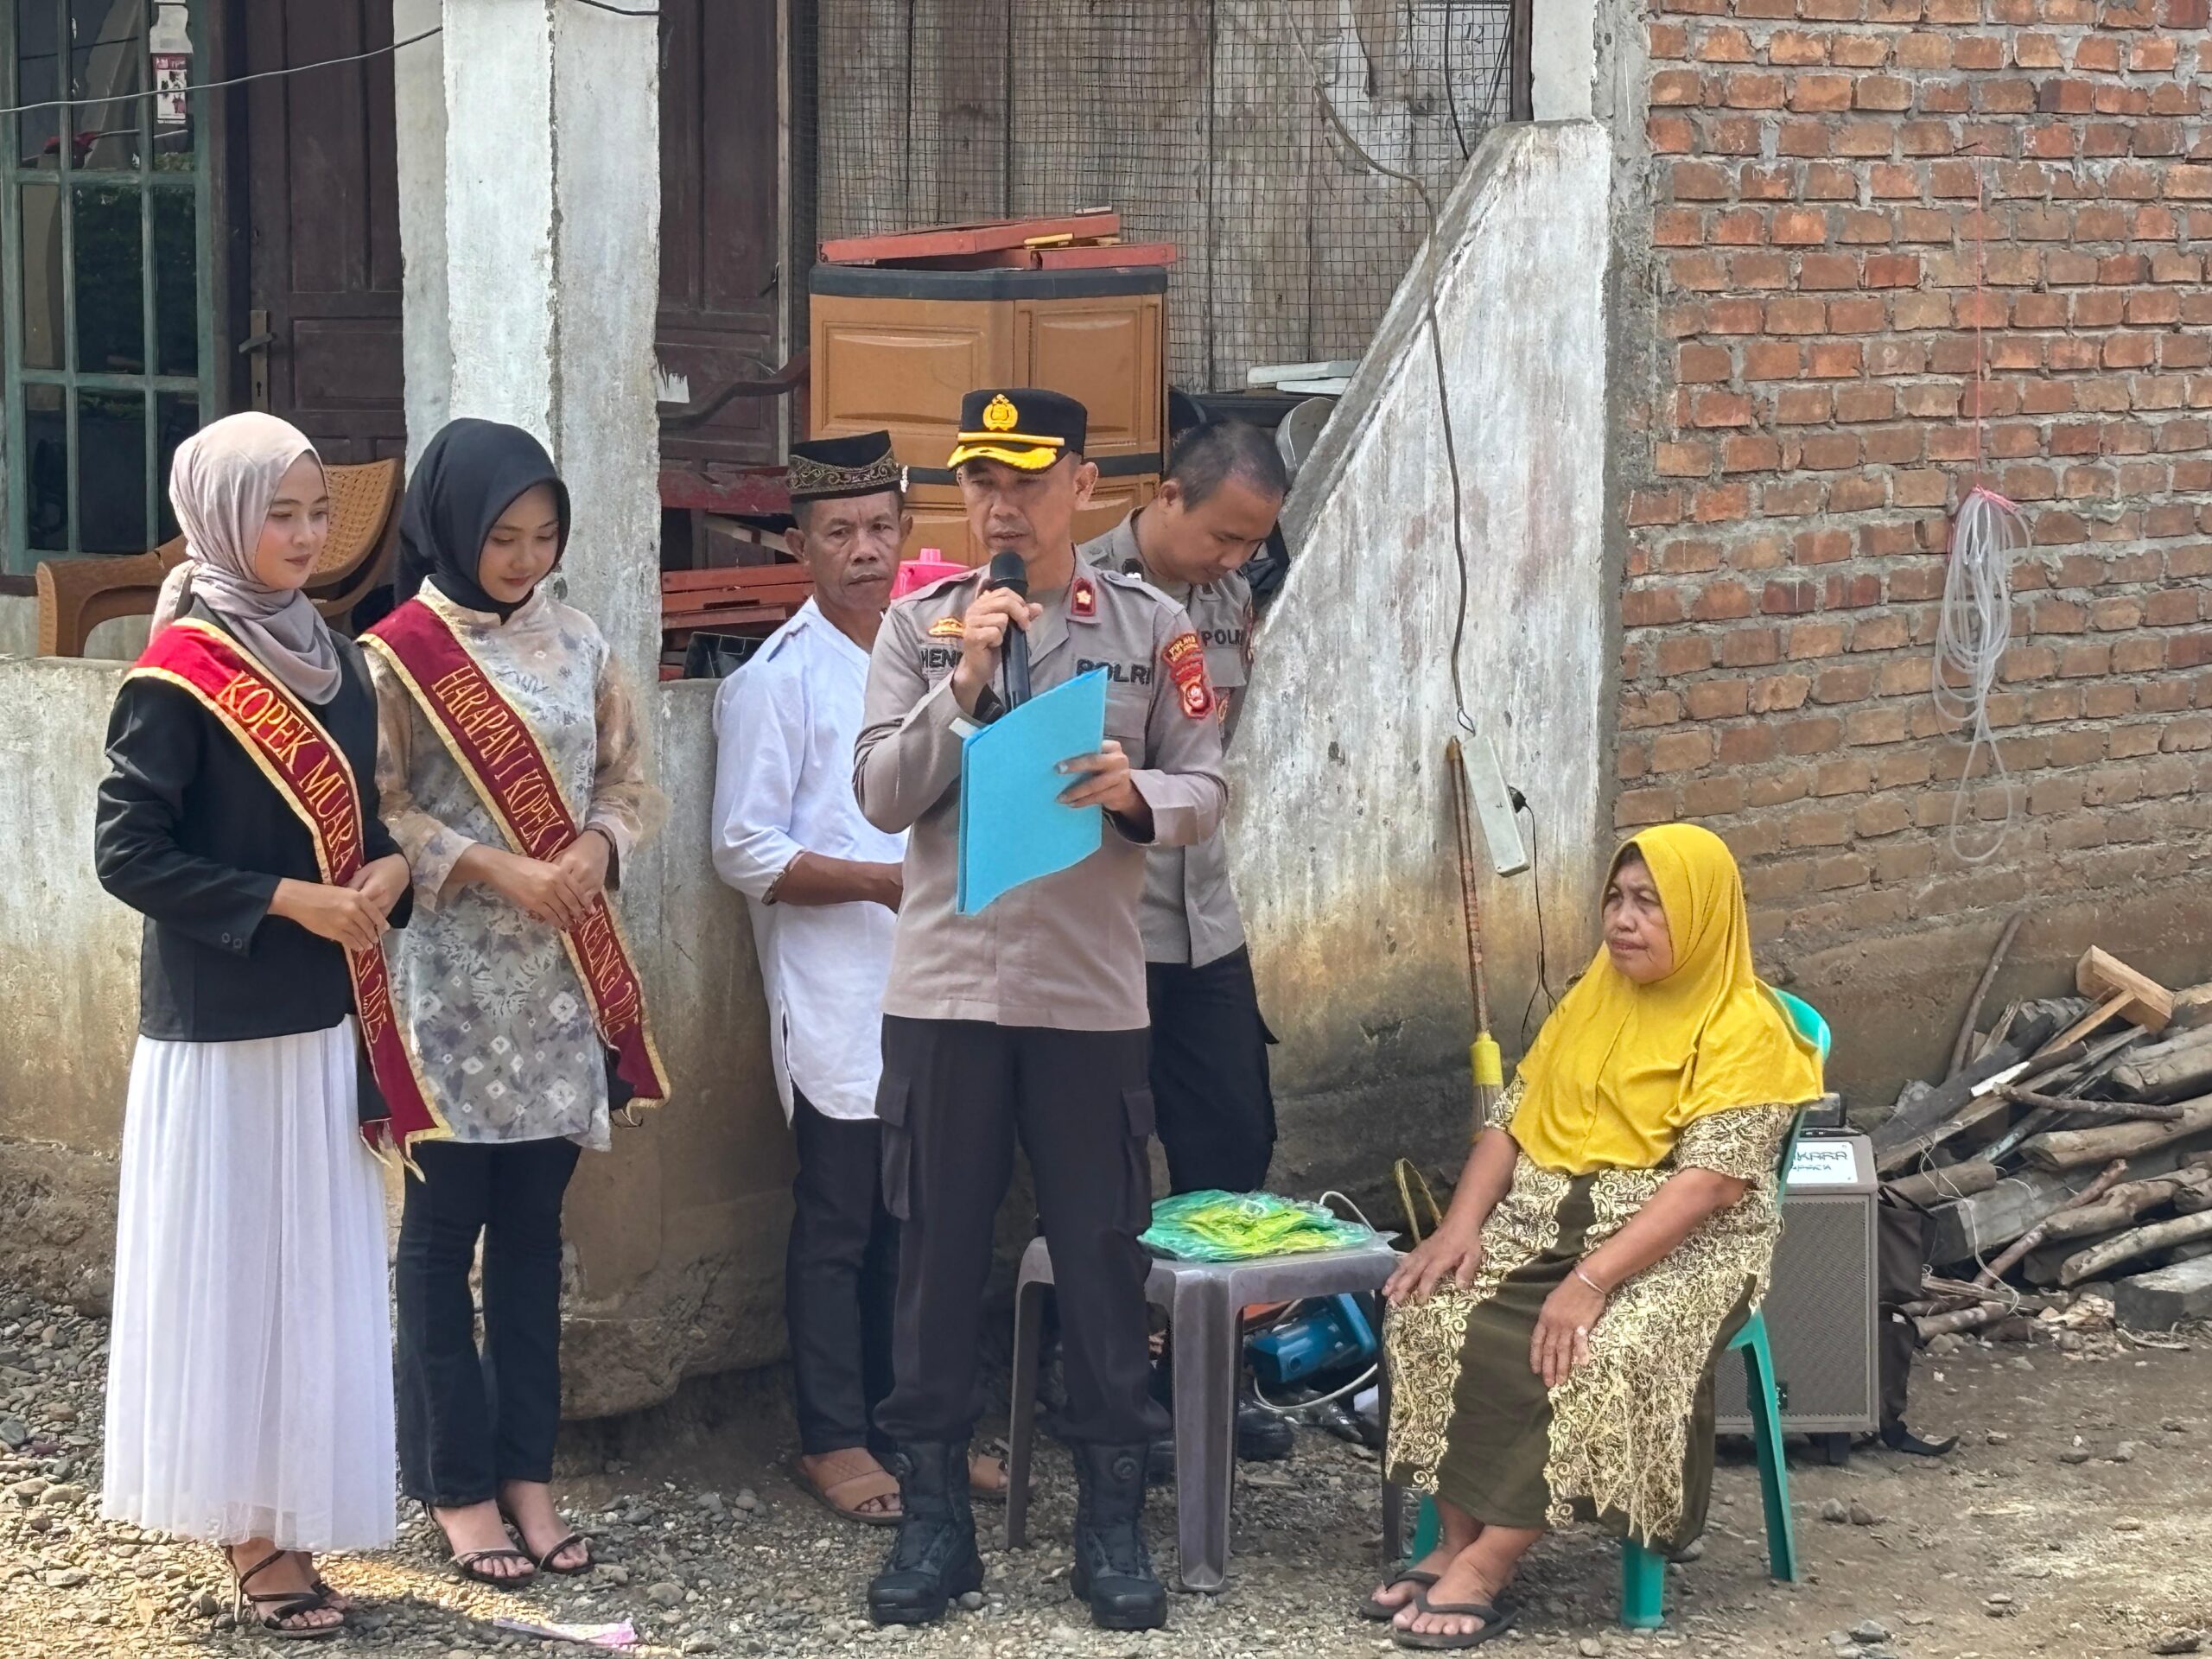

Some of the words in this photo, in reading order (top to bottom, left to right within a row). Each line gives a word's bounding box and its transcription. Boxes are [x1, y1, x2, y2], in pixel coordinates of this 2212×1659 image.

[431, 663, 527, 767] HARAPAN
[218, 670, 321, 775] KOPEK
[297, 751, 358, 880] MUARA
[493, 752, 534, 782] I
[502, 768, 565, 852] KOPEK
